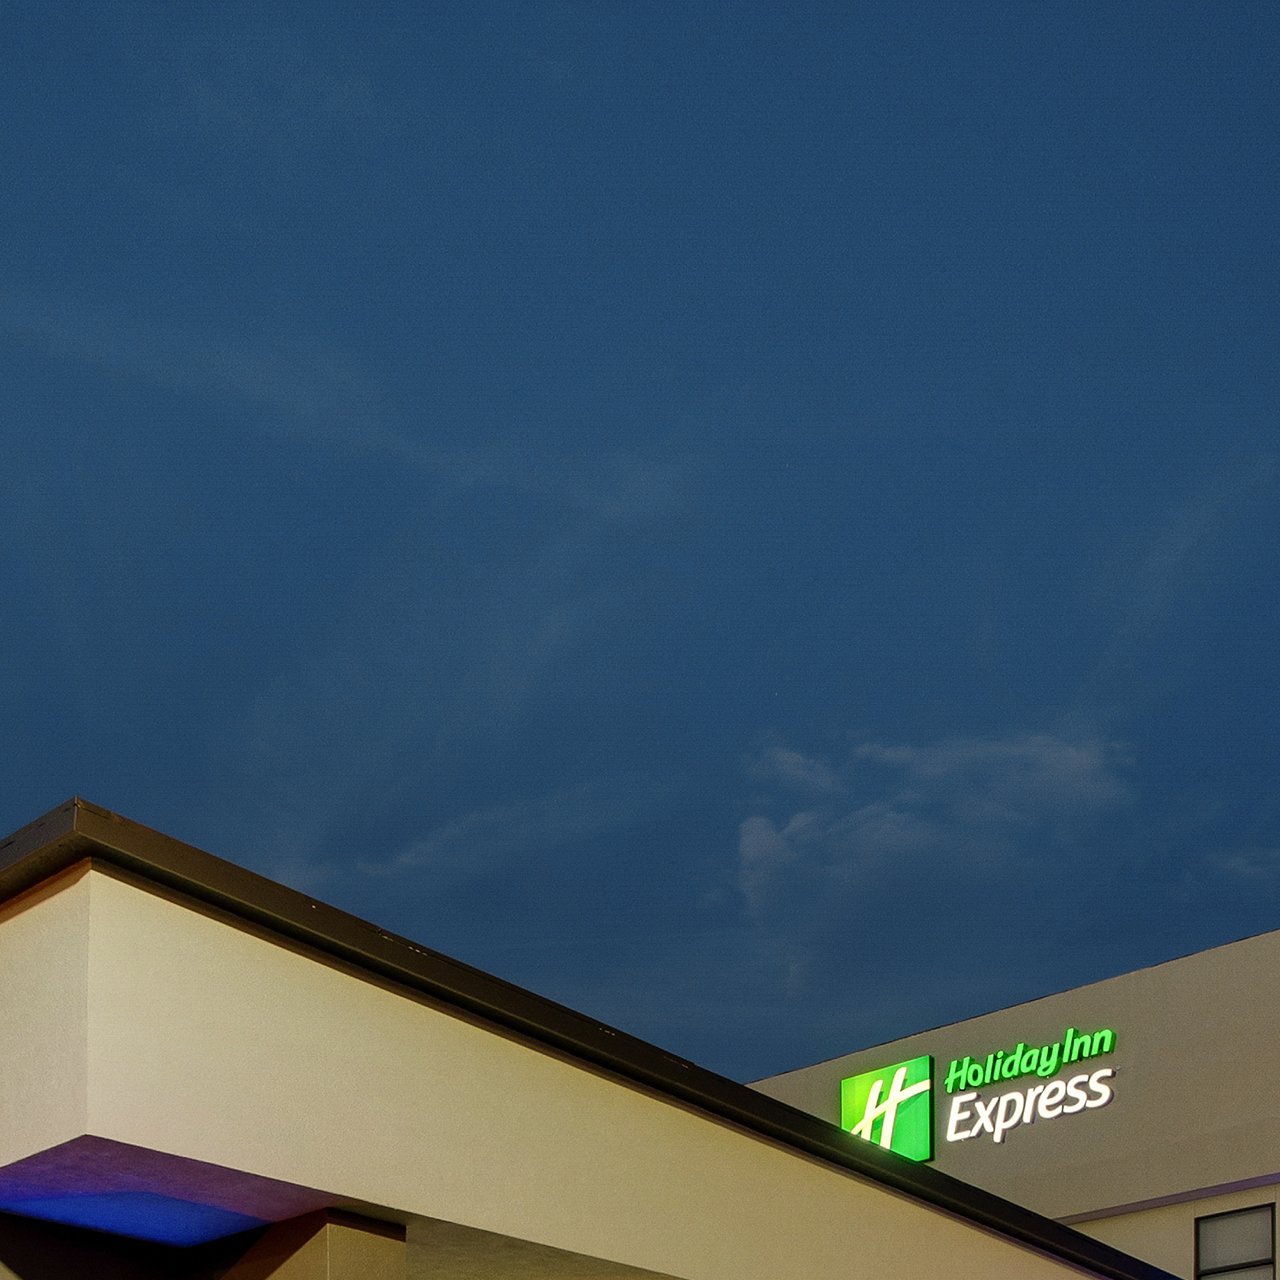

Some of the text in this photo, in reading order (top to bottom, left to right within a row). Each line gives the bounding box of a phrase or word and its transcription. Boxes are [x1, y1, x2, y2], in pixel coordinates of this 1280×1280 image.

[944, 1027, 1114, 1094] Holiday Inn
[946, 1068, 1114, 1144] Express
